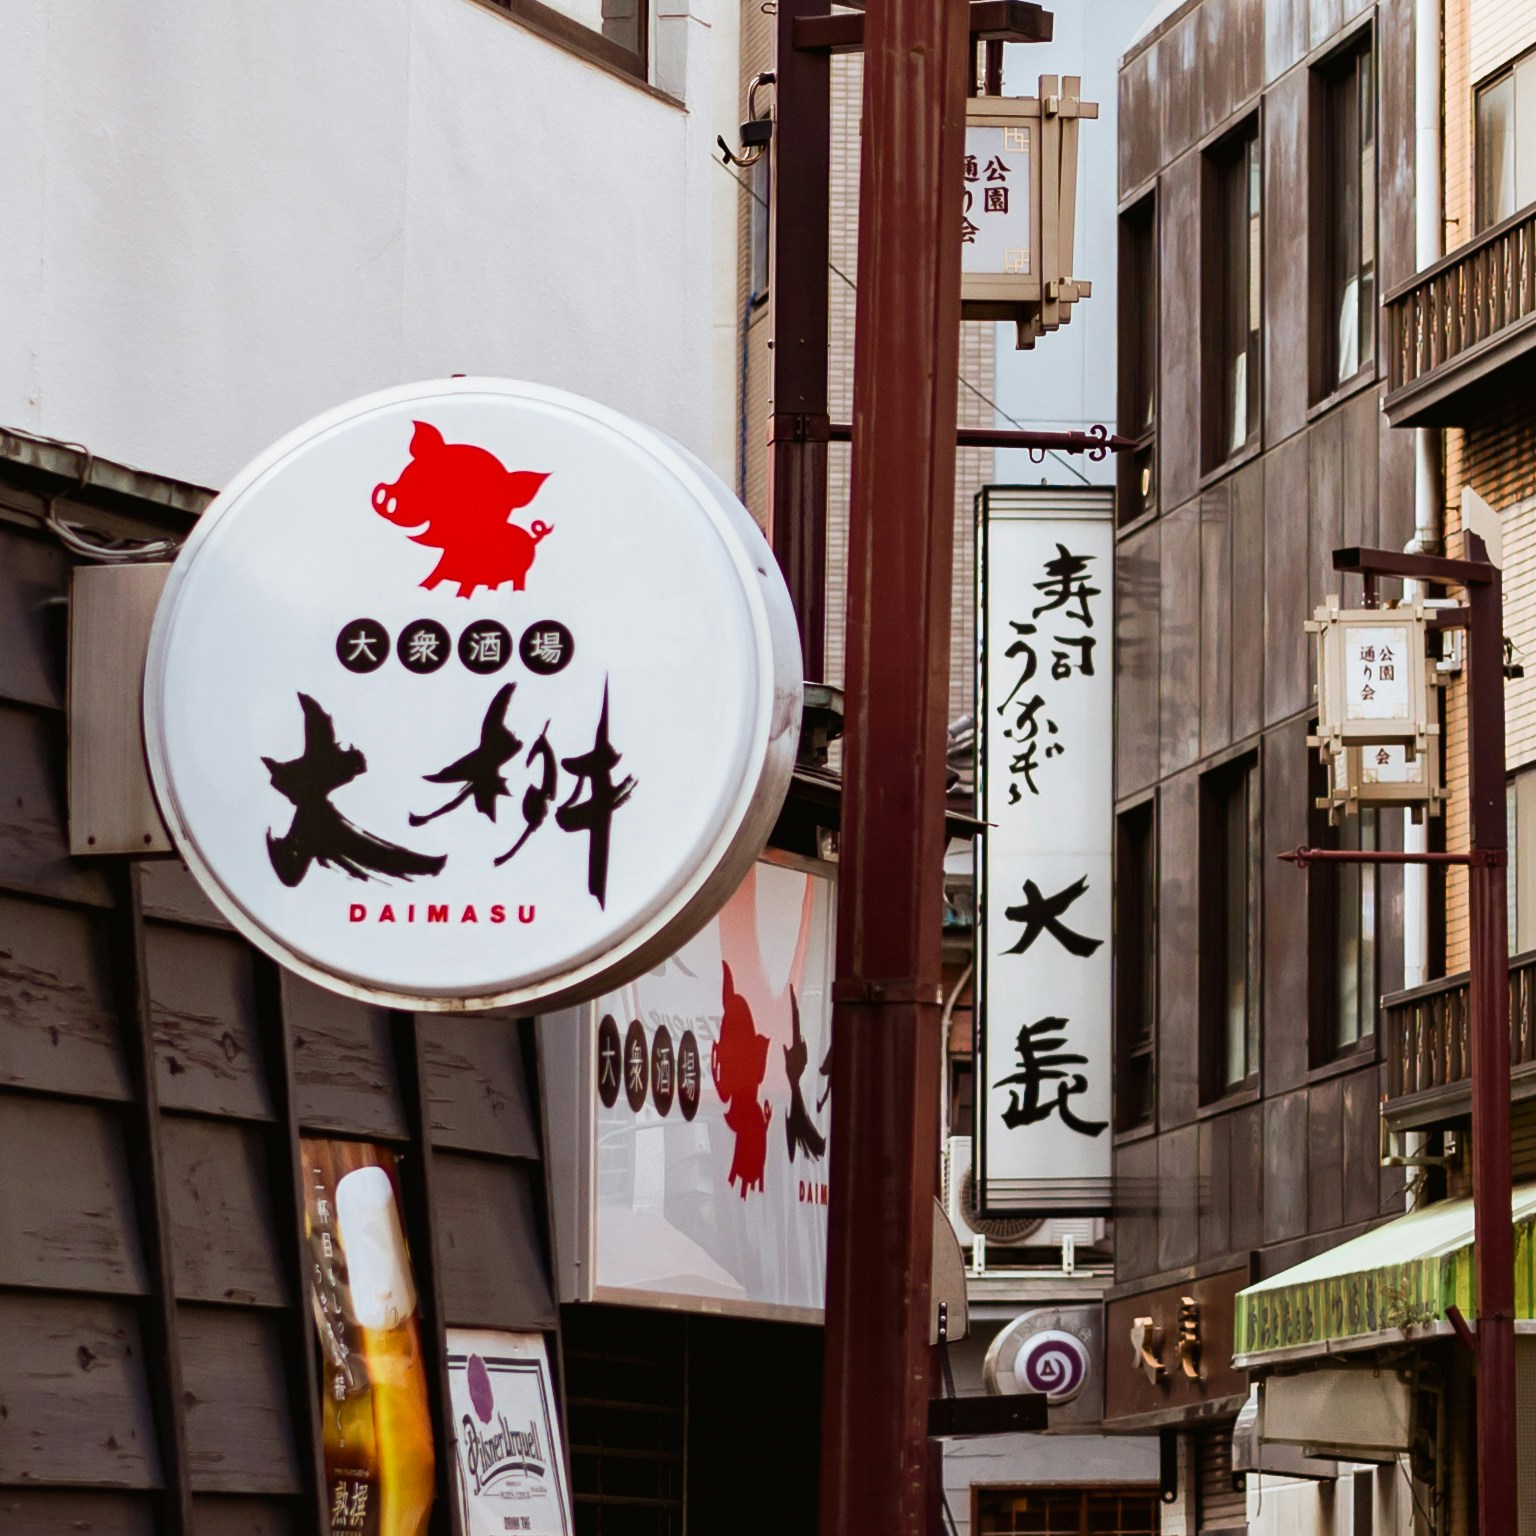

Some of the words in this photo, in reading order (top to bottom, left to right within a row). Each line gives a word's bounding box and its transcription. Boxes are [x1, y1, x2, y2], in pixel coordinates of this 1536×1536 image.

[982, 155, 1011, 215] 公園
[1032, 543, 1102, 677] 寿司
[341, 624, 570, 669] 大衆酒場
[1360, 645, 1375, 701] 通り会
[1379, 645, 1395, 681] 公園
[349, 903, 537, 924] DAIMASU
[599, 1025, 698, 1111] 大衆酒場
